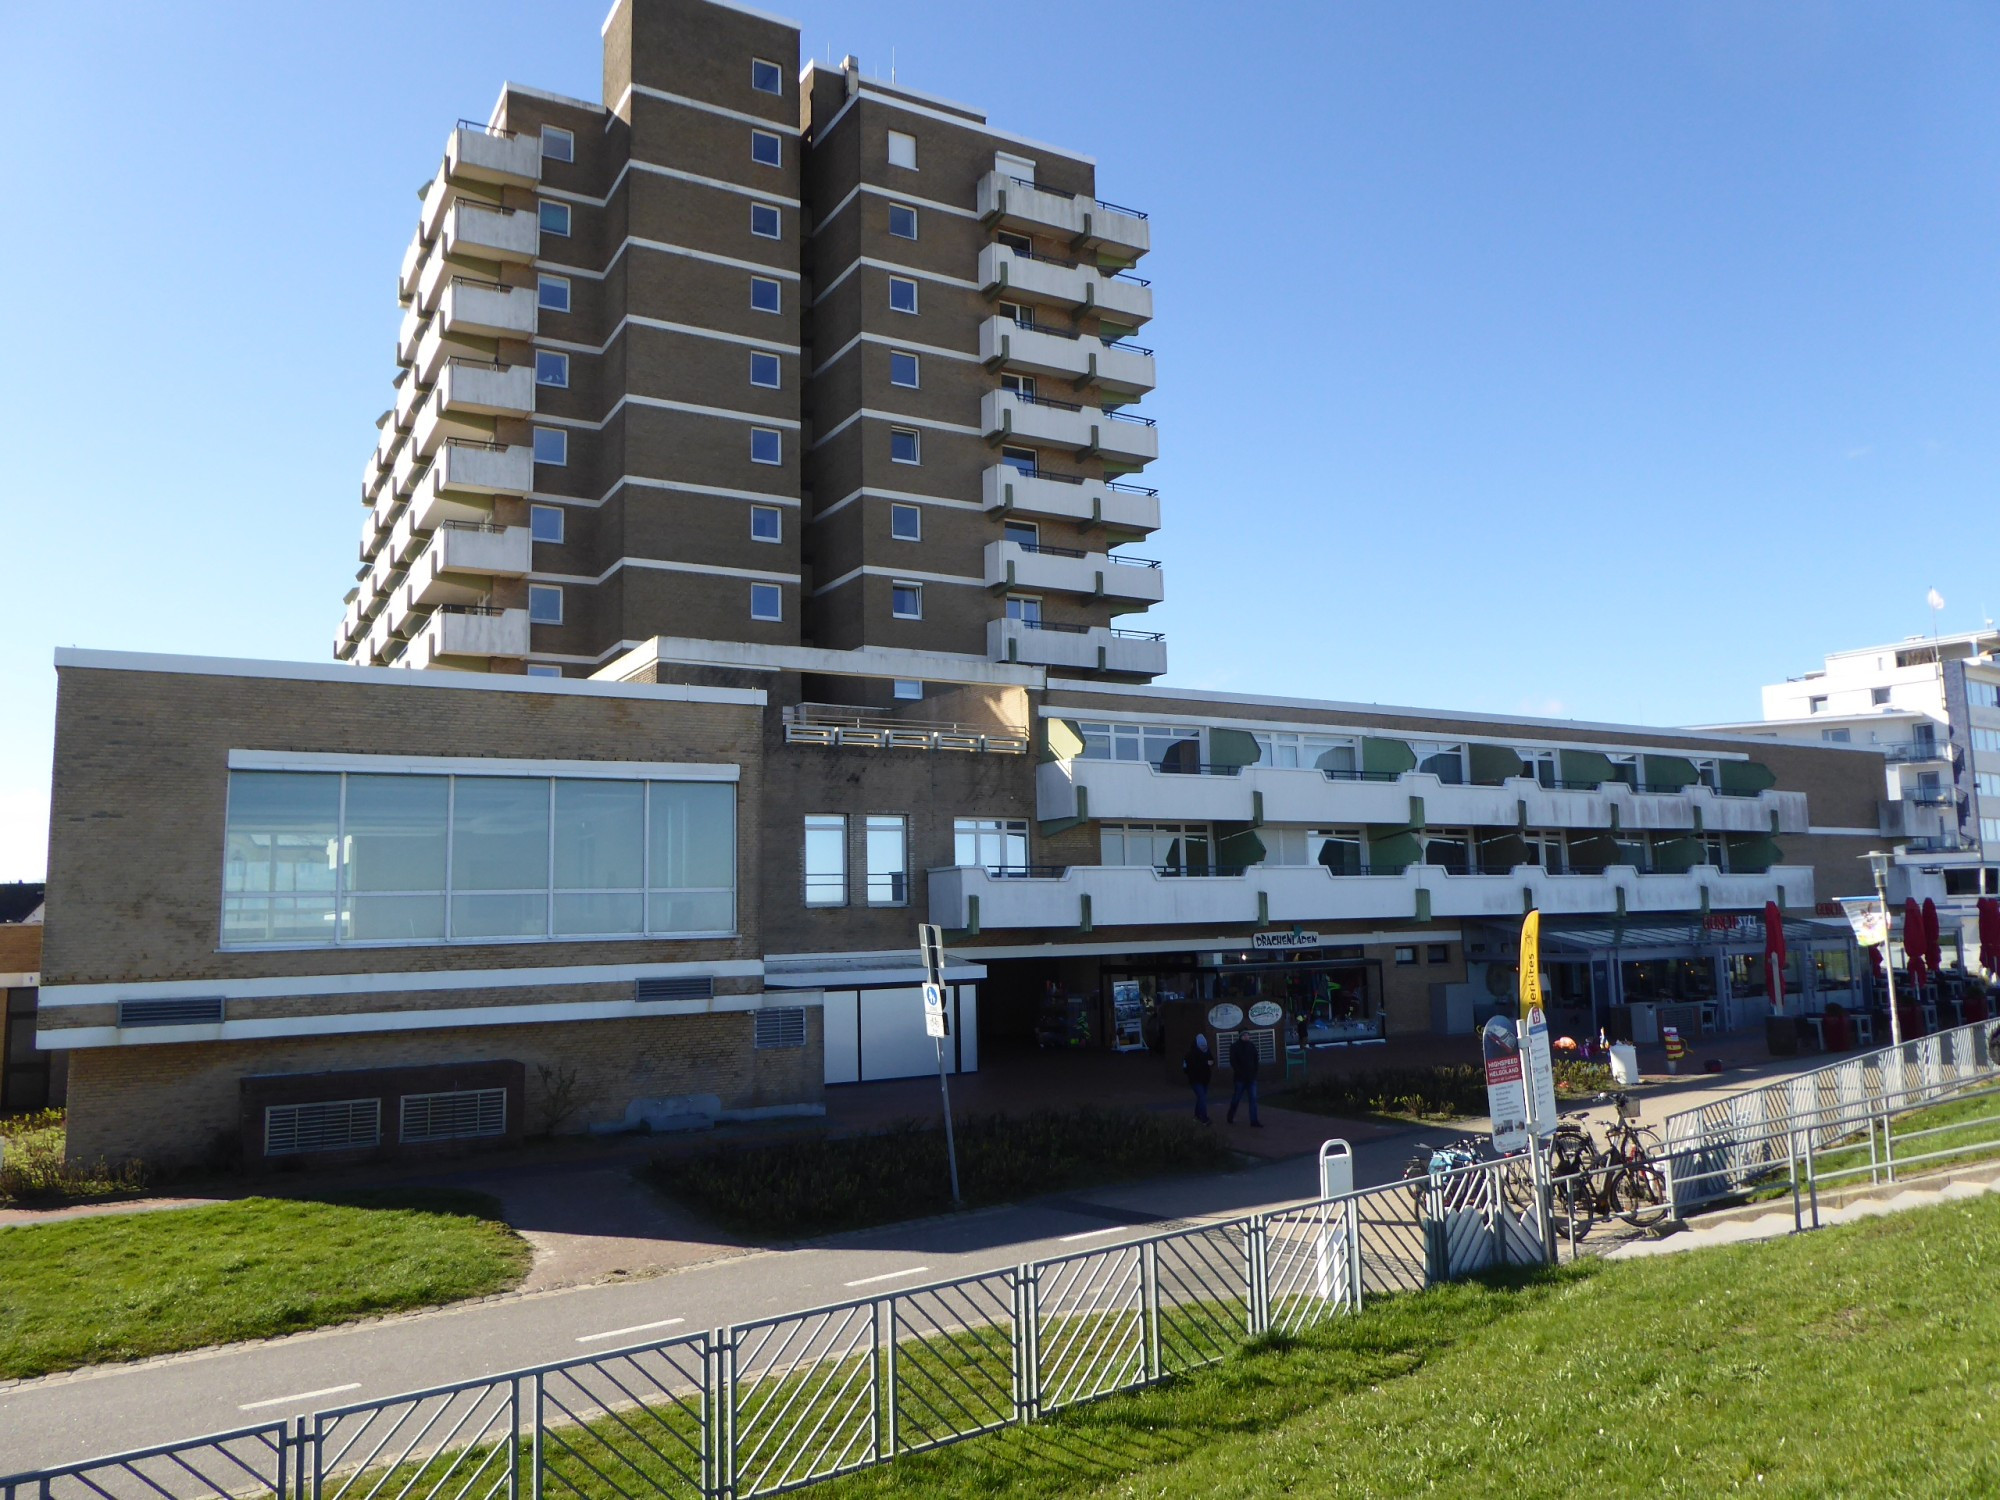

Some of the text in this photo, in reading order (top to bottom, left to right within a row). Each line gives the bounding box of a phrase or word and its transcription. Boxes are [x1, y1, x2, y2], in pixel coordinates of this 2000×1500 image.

[1256, 934, 1317, 946] DRACHENLADEN
[1488, 1057, 1518, 1069] HIGHSPEED
[1489, 1067, 1519, 1078] HELGOLAND
